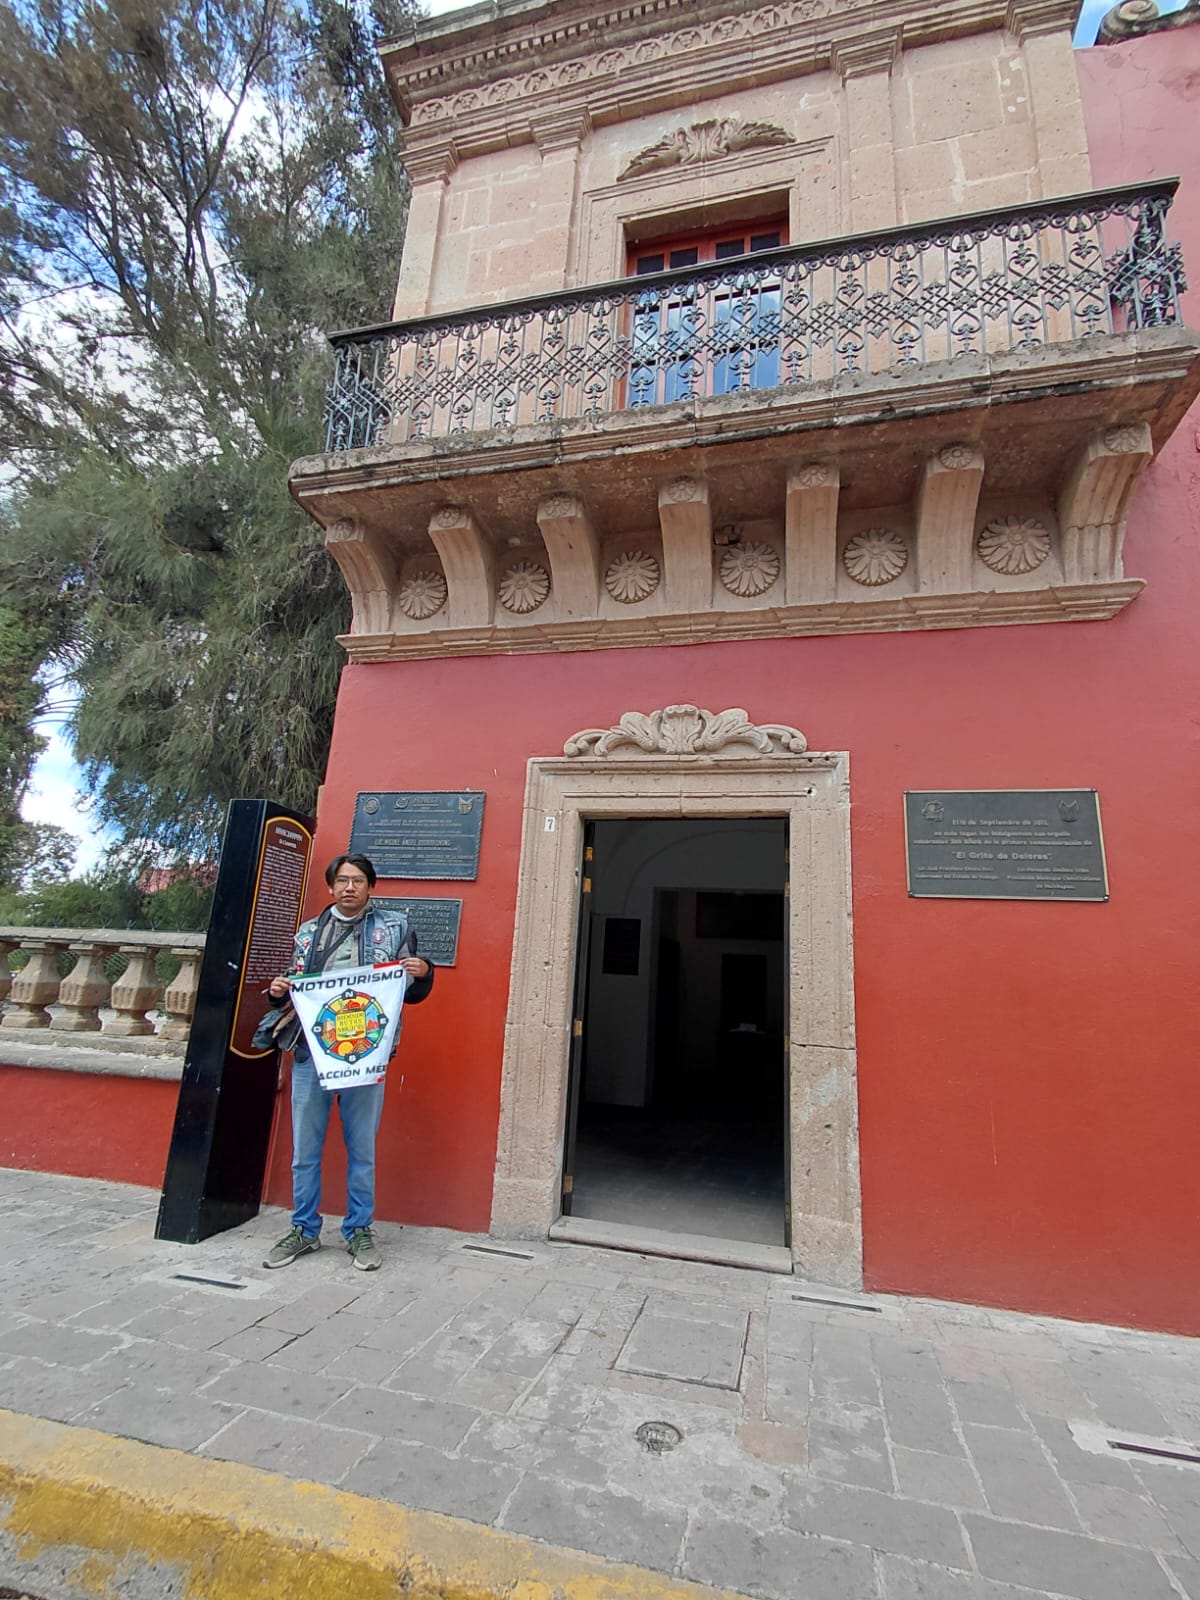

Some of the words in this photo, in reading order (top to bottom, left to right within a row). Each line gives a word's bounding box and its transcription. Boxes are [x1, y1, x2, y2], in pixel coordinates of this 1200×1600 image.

[547, 818, 554, 830] 7
[969, 851, 993, 859] Grito
[997, 852, 1008, 860] de
[292, 969, 404, 992] MOTOTURISMO
[345, 990, 354, 998] N
